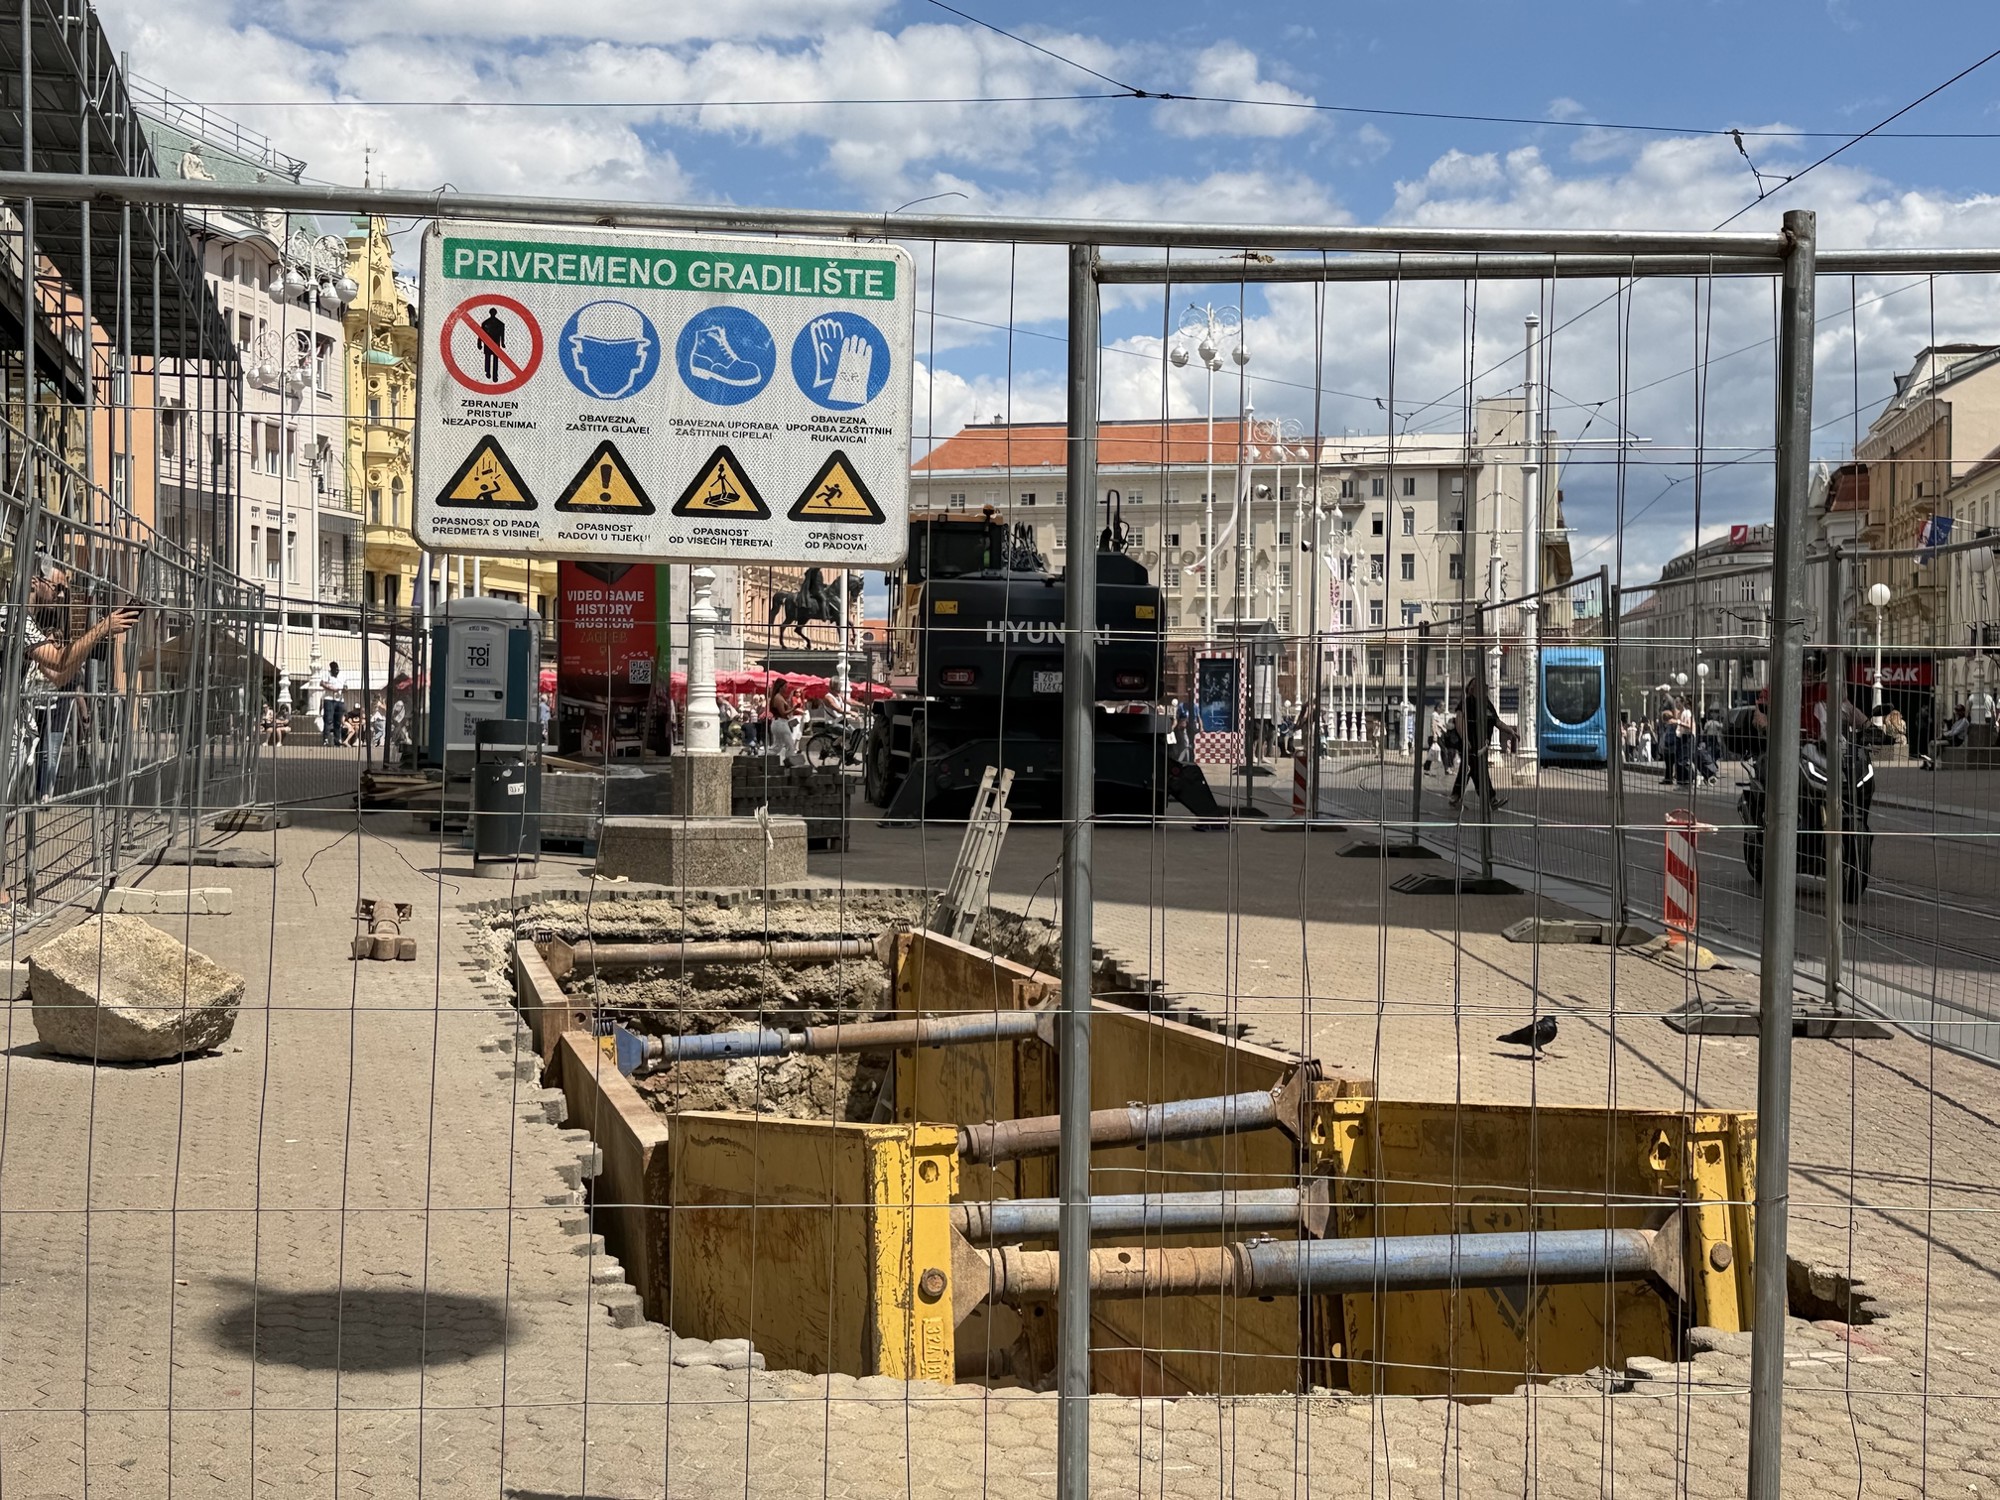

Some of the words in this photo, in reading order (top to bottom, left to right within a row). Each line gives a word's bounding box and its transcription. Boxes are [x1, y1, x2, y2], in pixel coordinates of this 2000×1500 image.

[454, 249, 676, 286] PRIVREMENO
[688, 261, 884, 297] GRADILIŠTE
[461, 400, 519, 410] ZBRANJEN
[467, 410, 512, 419] PRISTUP
[579, 415, 636, 424] OBAVEZNA
[442, 418, 537, 429] NEZAPOSLENIMA!
[669, 418, 725, 428] OBAVEZNA
[727, 420, 779, 430] UPORABA
[811, 416, 867, 425] OBAVEZNA
[566, 423, 609, 433] ZAŠTITA
[611, 426, 650, 434] GLAVE!
[675, 428, 729, 438] ZAŠTITNIH
[732, 431, 772, 440] CIPELA!
[786, 424, 837, 433] UPORABA
[839, 425, 892, 436] ZAŠTITNIH
[811, 434, 867, 444] RUKAVICA!
[432, 517, 490, 526] OPASNOST
[493, 519, 508, 527] OD
[511, 520, 540, 528] PADA
[576, 523, 633, 532] OPASNOST
[432, 527, 490, 536] PREDMETA
[492, 528, 499, 537] S
[502, 529, 540, 538] VISINE!
[558, 532, 598, 541] RADOVI
[601, 533, 608, 541] U
[693, 528, 749, 537] OPASNOST
[808, 532, 864, 541] OPASNOST
[669, 536, 684, 544] OD
[687, 535, 727, 546] VISEĆIH
[731, 538, 773, 547] TERETA!
[805, 541, 820, 549] OD
[823, 542, 867, 551] PADOVA!
[567, 590, 602, 601] VIDEO
[605, 590, 645, 601] GAME
[576, 604, 633, 615] HISTORY
[986, 620, 1110, 646] HYUNI
[1863, 667, 1919, 682] TSAK
